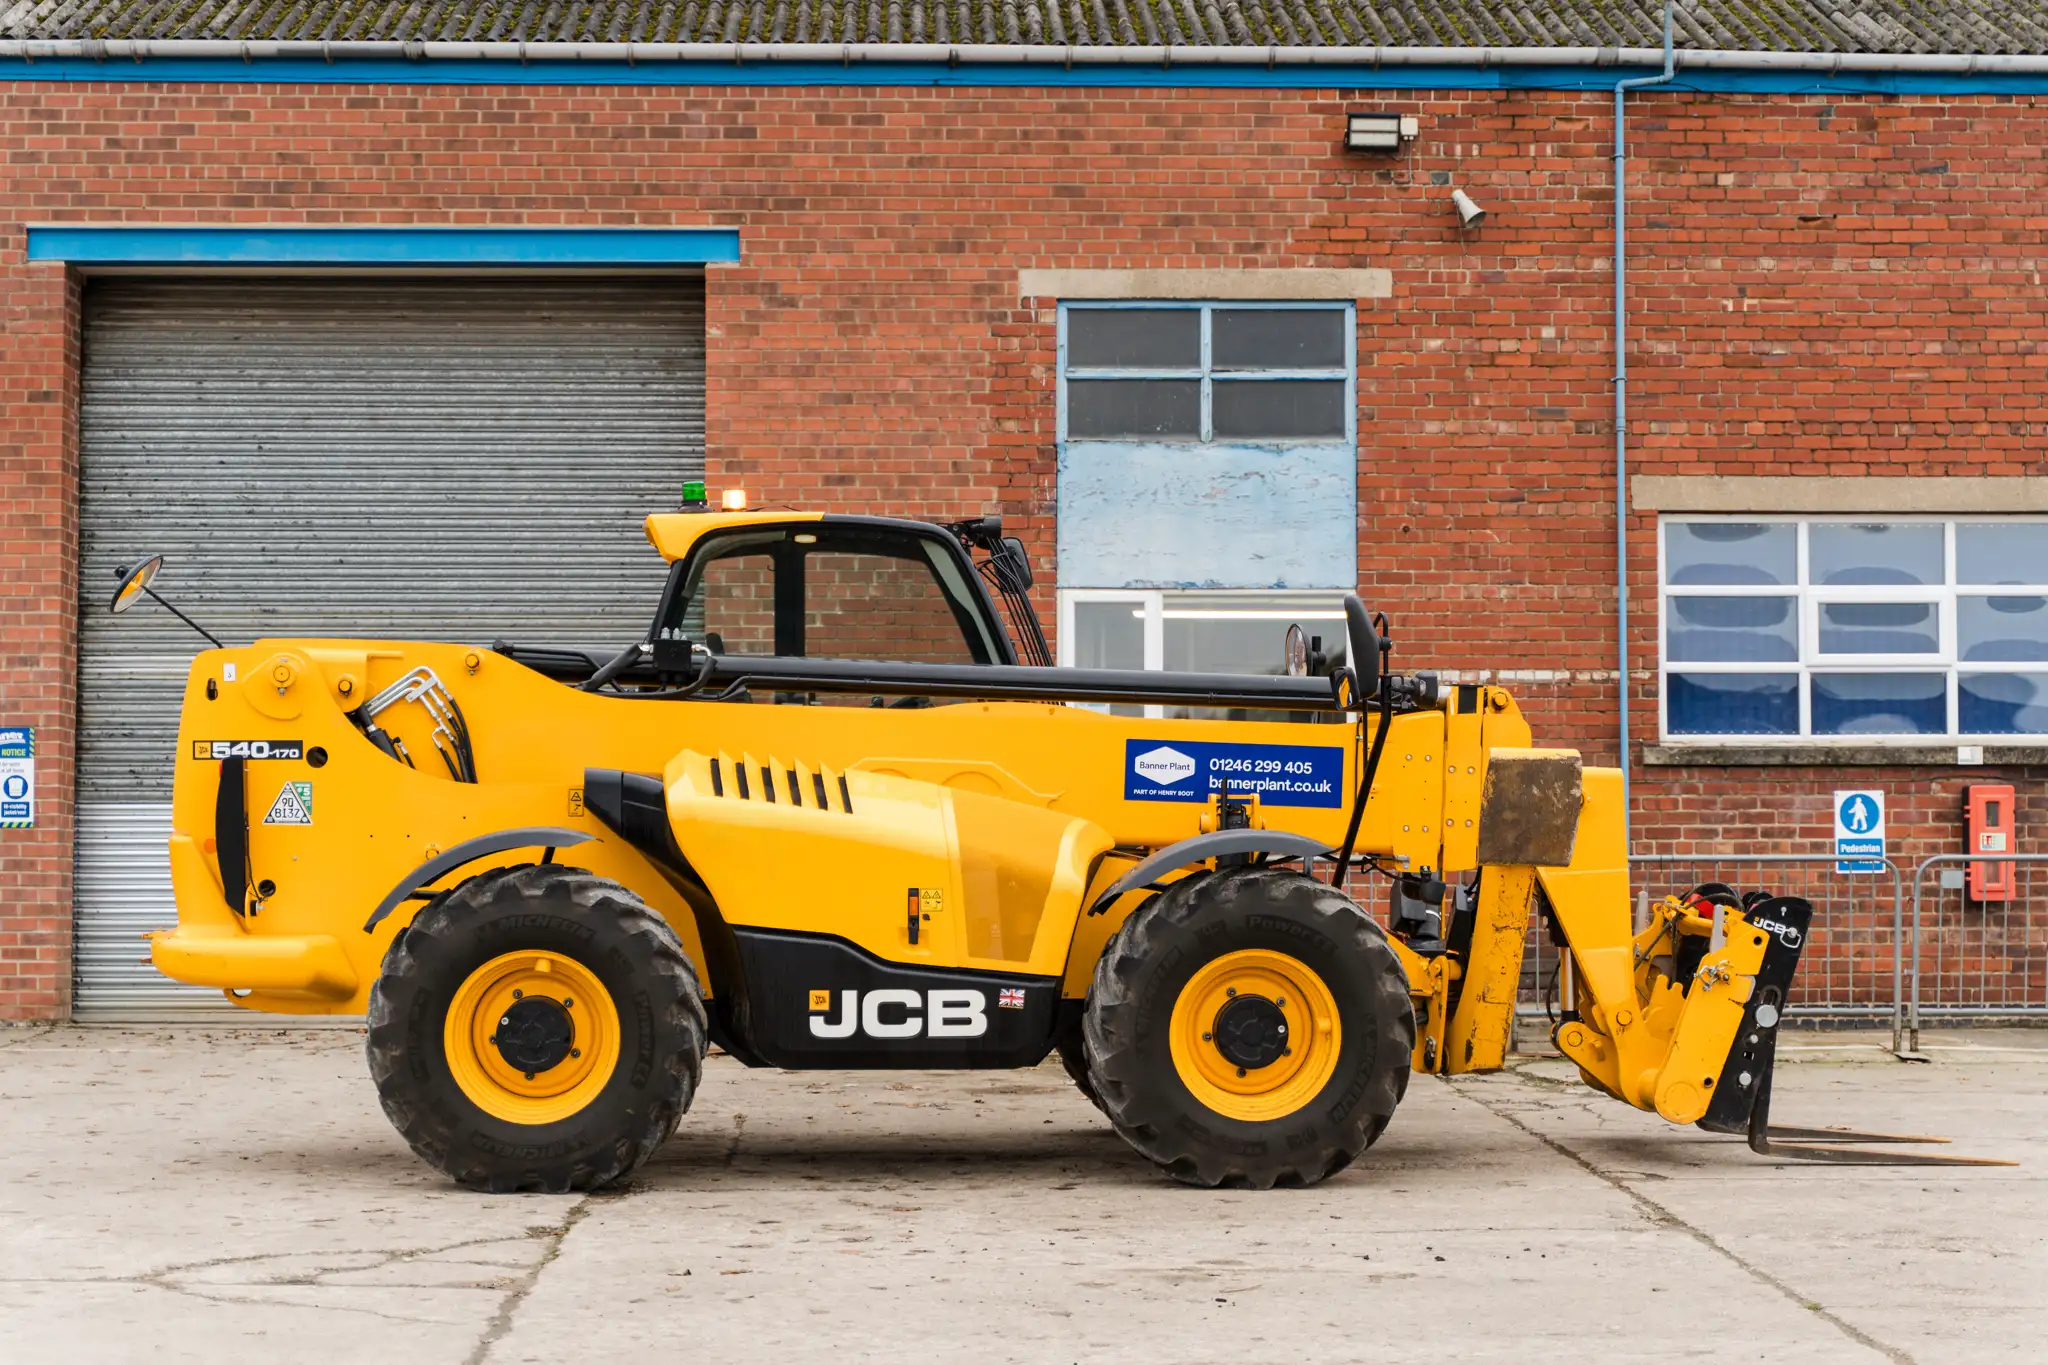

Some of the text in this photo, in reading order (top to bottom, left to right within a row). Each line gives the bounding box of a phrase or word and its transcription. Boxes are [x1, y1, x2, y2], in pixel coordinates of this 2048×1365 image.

[2, 748, 26, 757] NOTICE
[212, 741, 300, 758] 540-170
[1140, 761, 1191, 771] Banner Plant
[1209, 758, 1313, 775] 01246 299 405
[1753, 917, 1787, 935] JCB
[808, 988, 988, 1038] JCB
